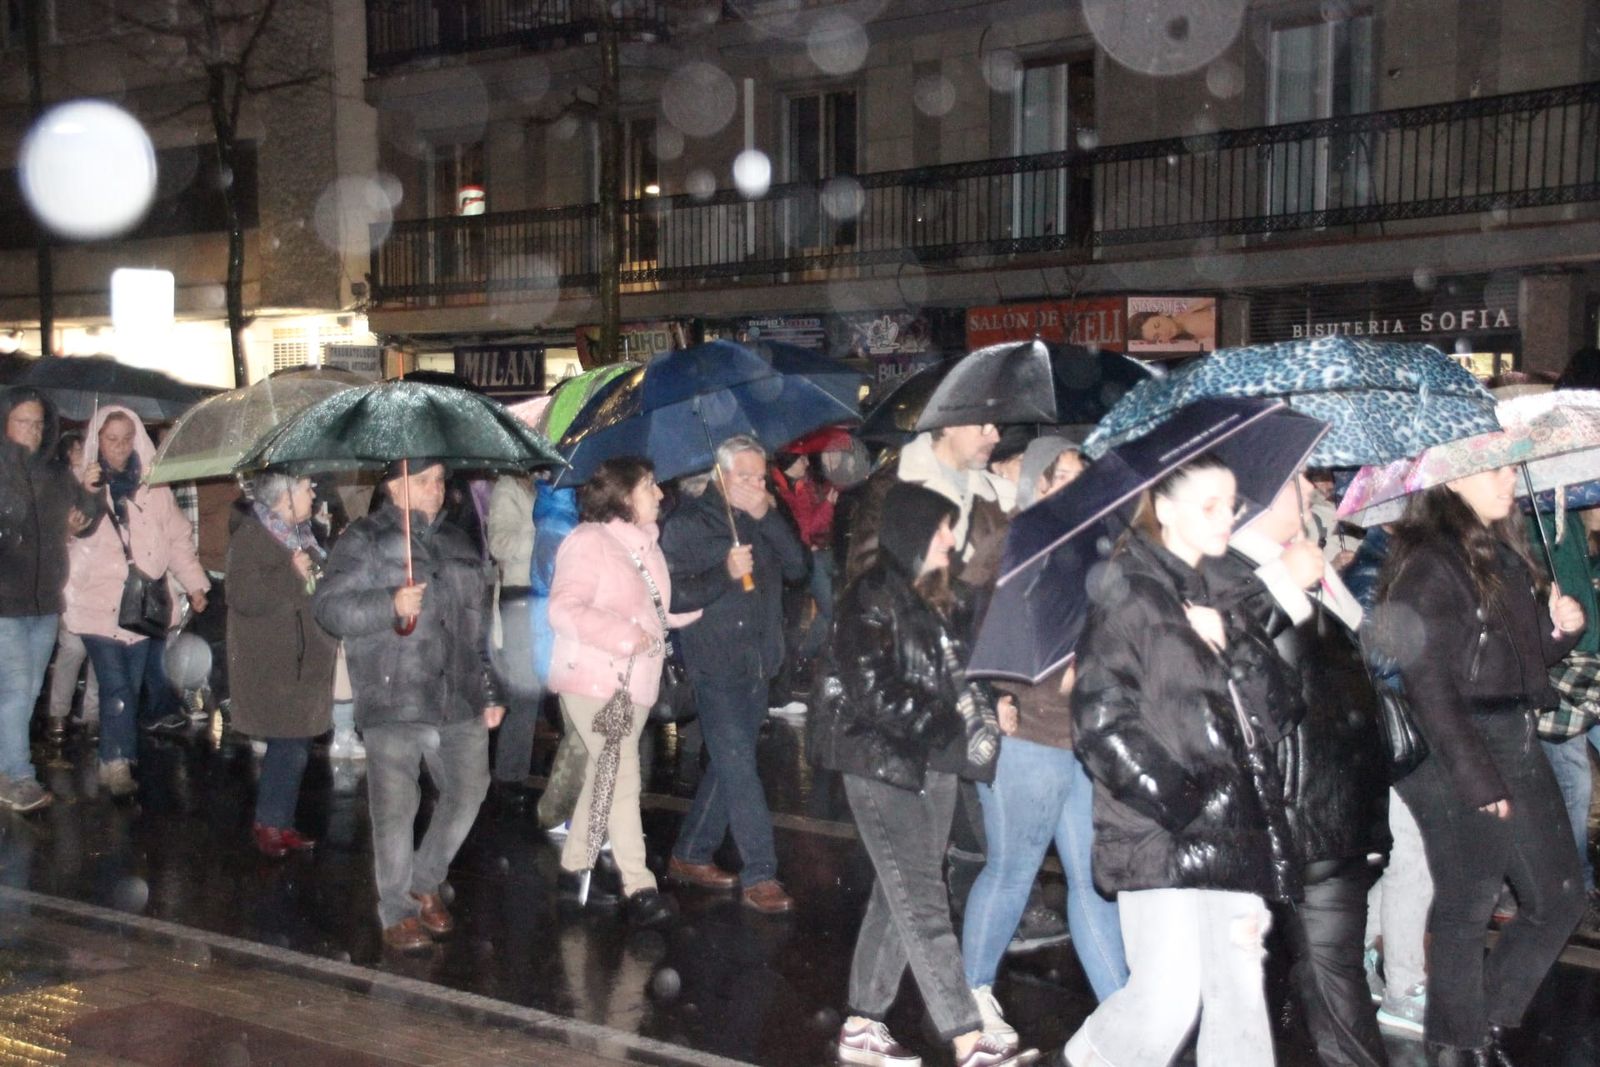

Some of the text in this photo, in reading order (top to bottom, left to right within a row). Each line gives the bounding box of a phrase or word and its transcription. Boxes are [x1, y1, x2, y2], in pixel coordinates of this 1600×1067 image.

[968, 310, 1030, 332] SALÓN
[1033, 310, 1059, 328] DE
[1292, 308, 1511, 338] BISUTERIA SOFIA
[463, 350, 537, 387] MILAN
